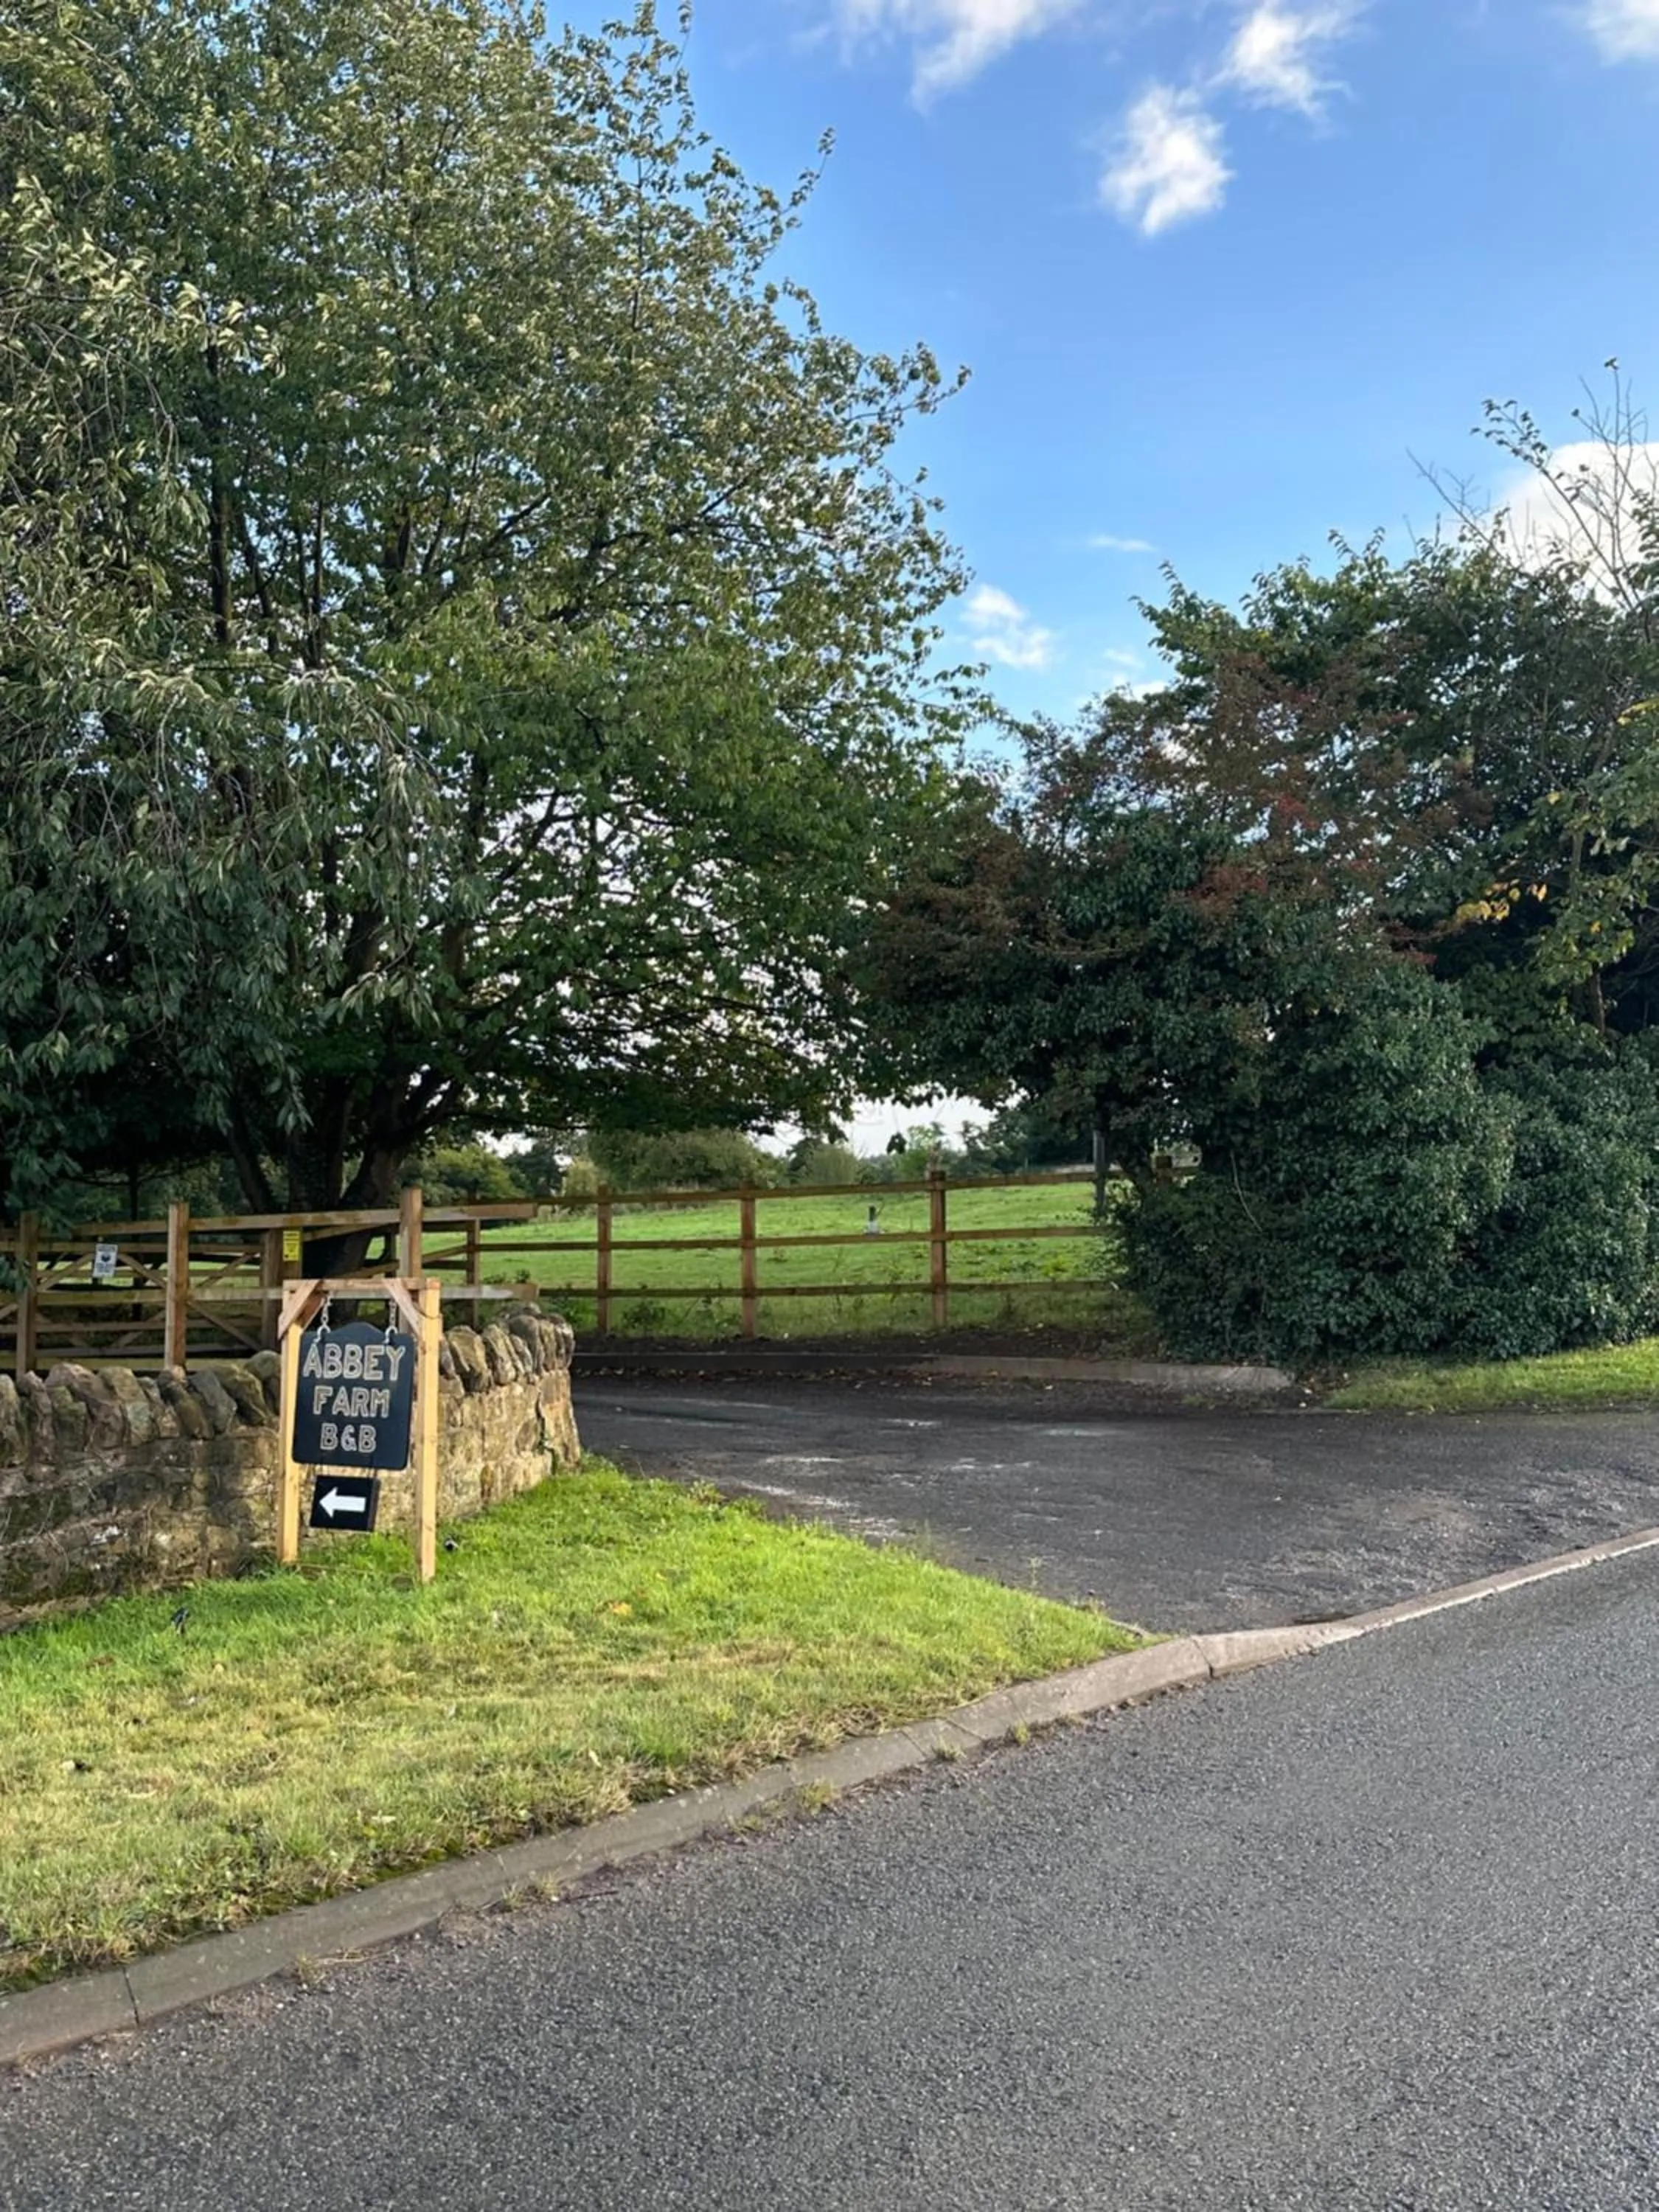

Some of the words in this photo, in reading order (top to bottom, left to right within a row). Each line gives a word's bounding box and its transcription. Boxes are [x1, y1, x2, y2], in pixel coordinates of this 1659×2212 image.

[303, 1343, 406, 1381] ABBEY
[313, 1385, 391, 1418] FARM
[319, 1422, 378, 1453] B&B
